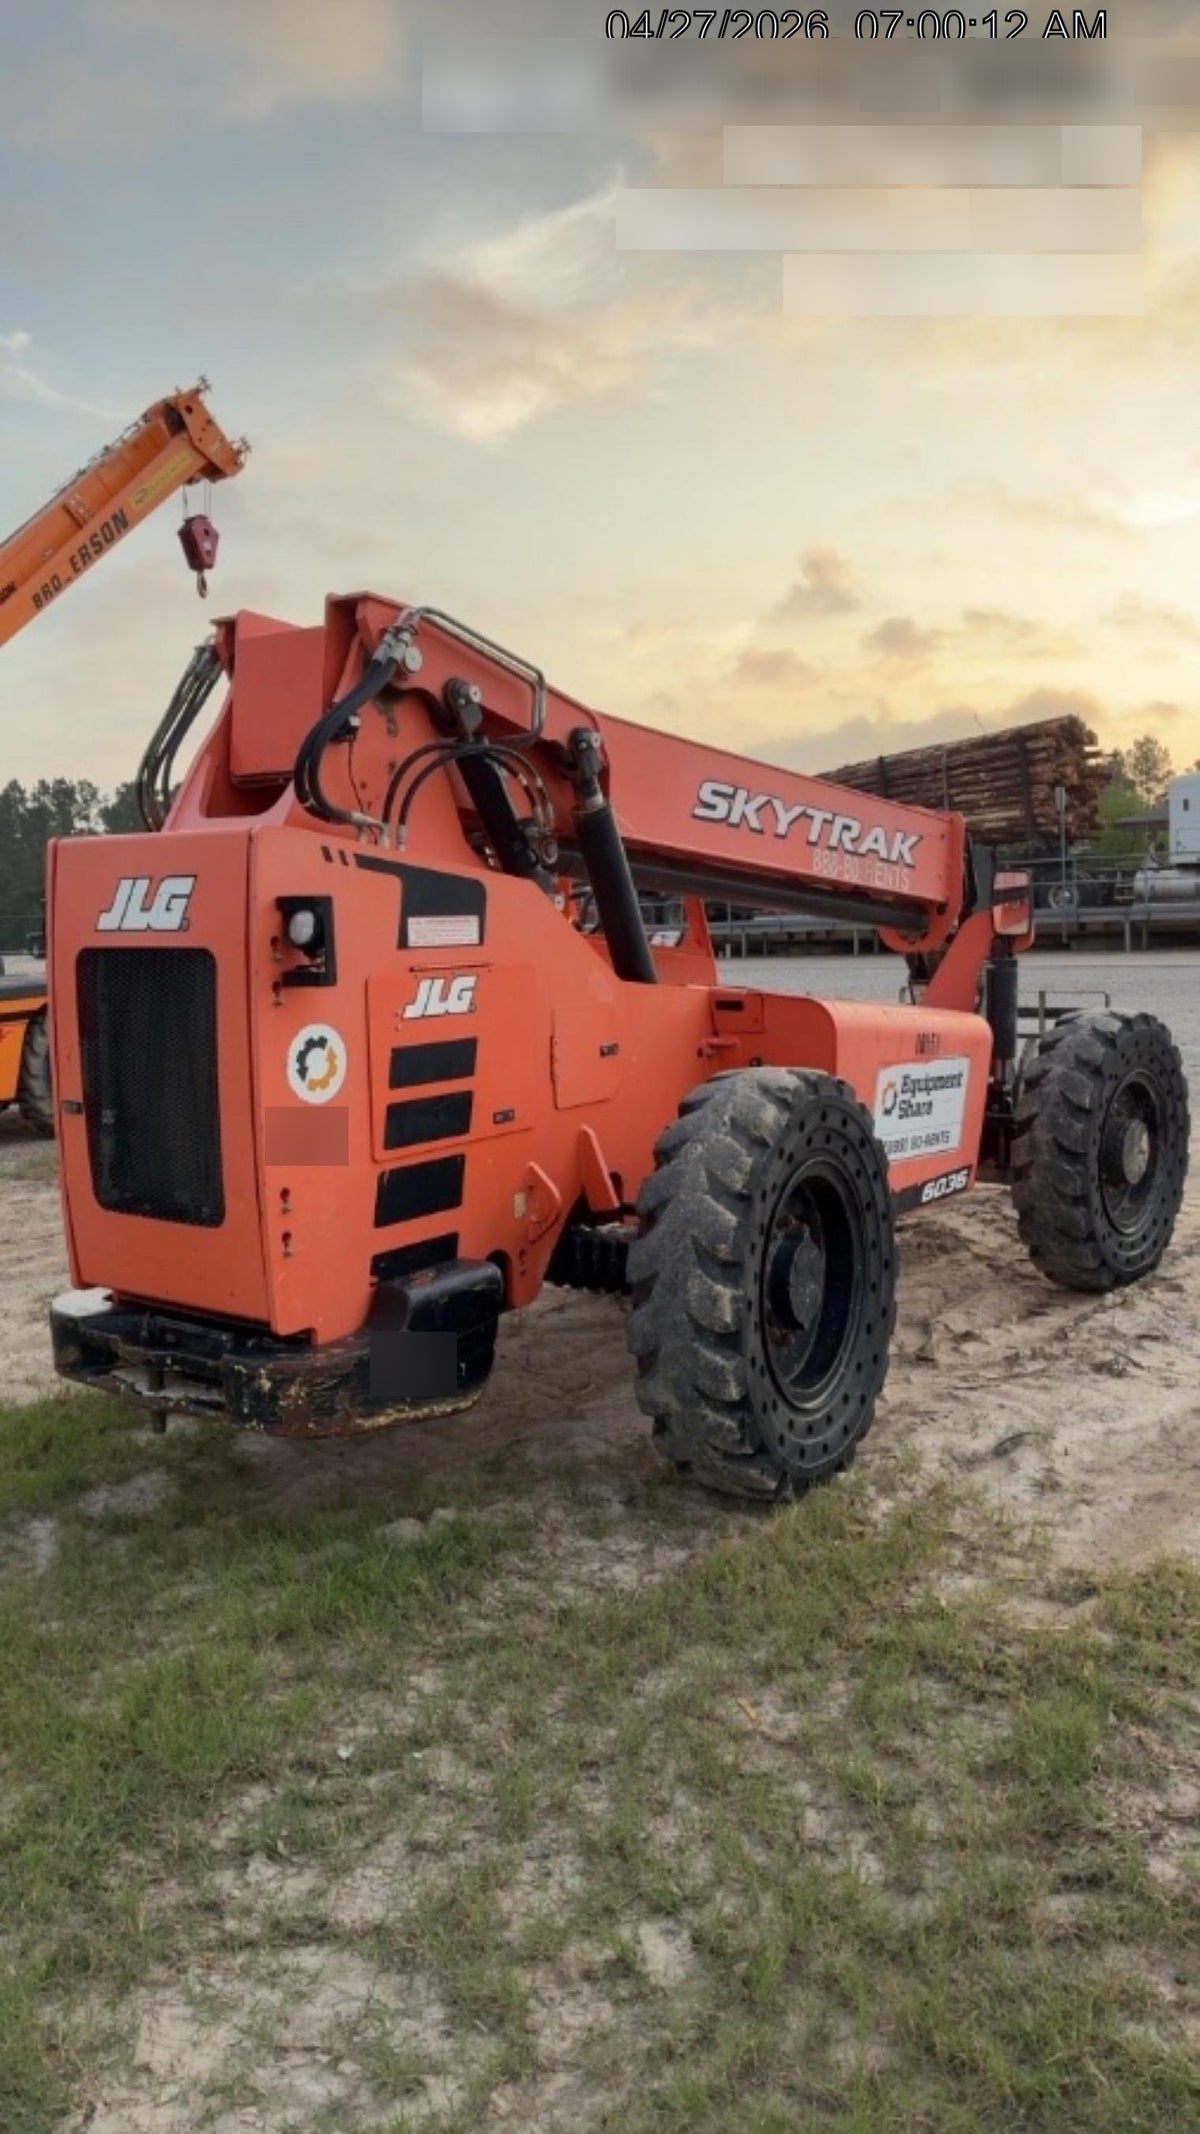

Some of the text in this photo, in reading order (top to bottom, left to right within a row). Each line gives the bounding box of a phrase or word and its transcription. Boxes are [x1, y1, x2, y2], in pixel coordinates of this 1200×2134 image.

[32, 508, 129, 610] BROERSON
[692, 780, 923, 867] SKYTRAK
[95, 875, 197, 932] JLG
[402, 975, 478, 1020] JLG
[901, 1071, 963, 1098] Equipment
[898, 1099, 932, 1119] Share
[922, 1168, 969, 1203] 6036
